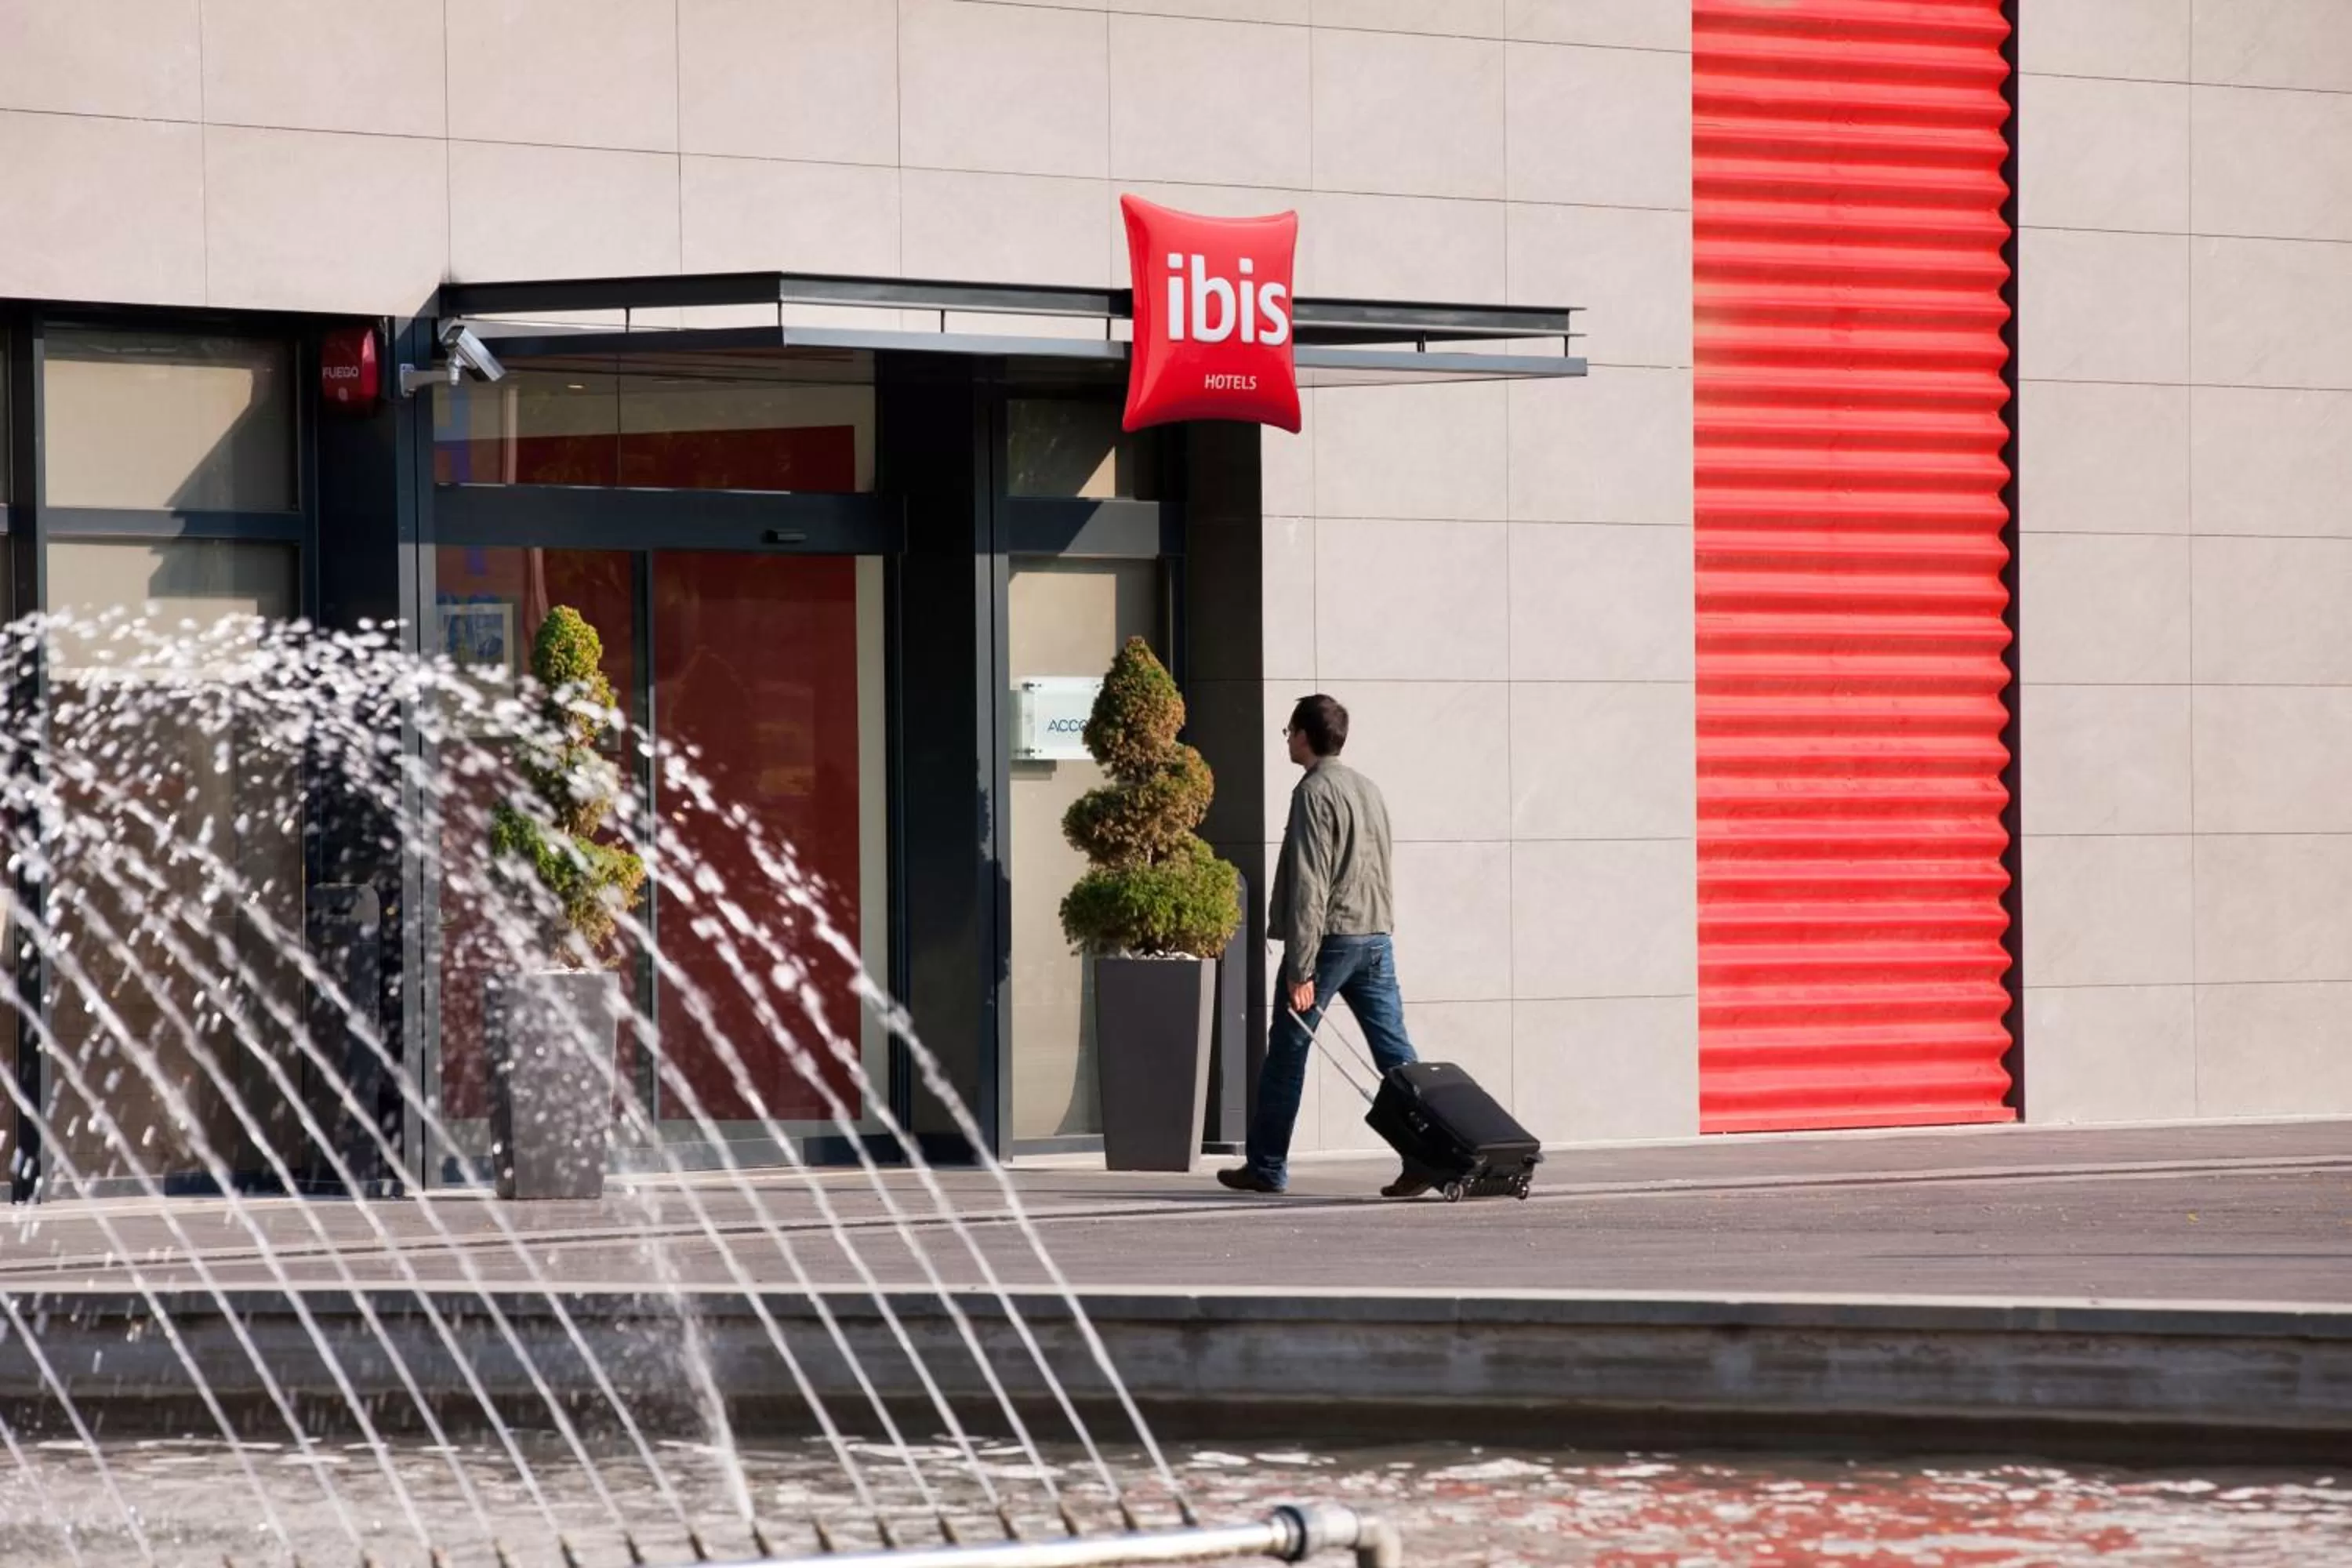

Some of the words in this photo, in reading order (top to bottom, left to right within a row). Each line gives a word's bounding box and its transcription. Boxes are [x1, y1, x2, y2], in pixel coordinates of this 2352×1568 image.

[1167, 252, 1289, 346] ibis
[322, 366, 359, 379] FUEGO
[1204, 374, 1257, 390] HOTELS
